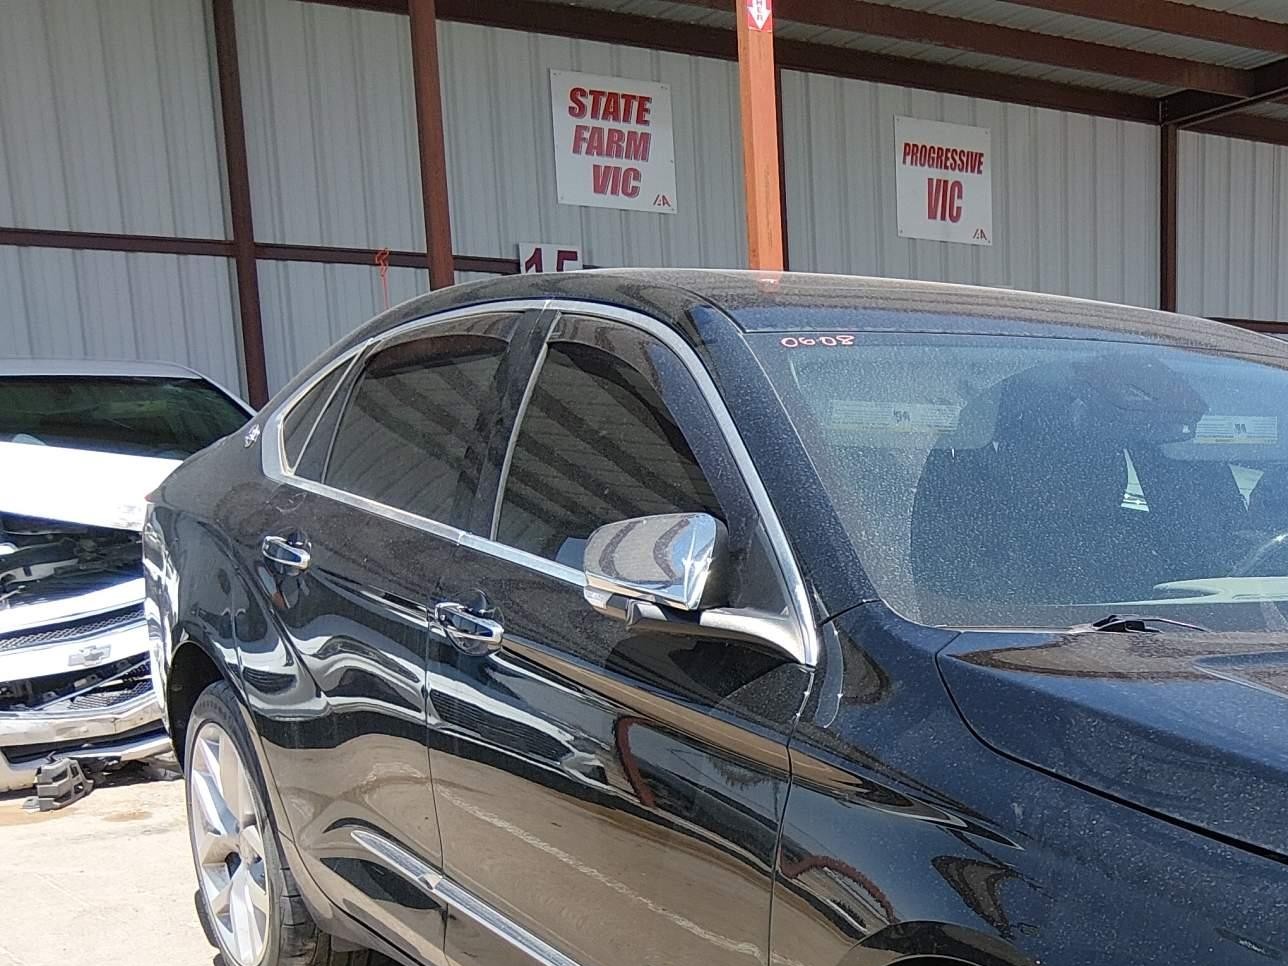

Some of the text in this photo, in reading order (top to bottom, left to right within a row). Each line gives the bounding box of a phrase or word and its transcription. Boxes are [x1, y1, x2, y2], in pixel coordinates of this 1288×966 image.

[568, 86, 653, 127] STATE
[572, 124, 652, 163] FARM
[902, 142, 985, 175] PROGRESSIVE
[592, 163, 642, 199] VIC
[927, 177, 963, 223] VIC
[780, 334, 855, 348] 0608
